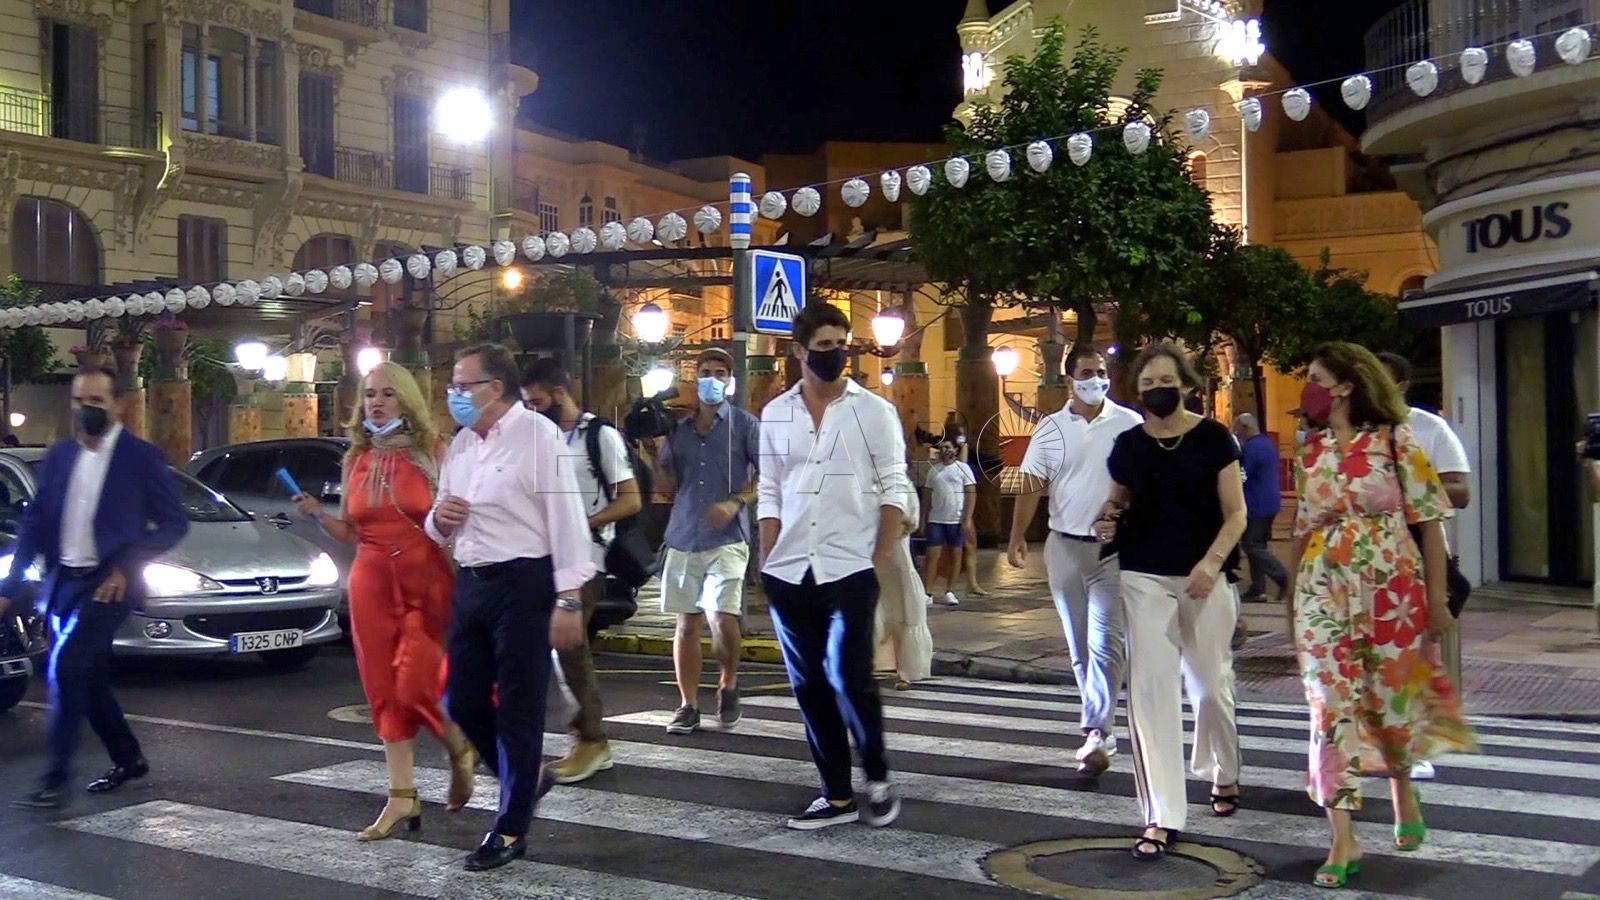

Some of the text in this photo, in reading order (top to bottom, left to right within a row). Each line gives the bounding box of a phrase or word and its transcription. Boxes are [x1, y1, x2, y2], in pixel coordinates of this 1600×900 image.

[1462, 201, 1571, 253] TOUS
[1465, 297, 1512, 318] TOUS
[241, 632, 299, 650] 1325 CNP
